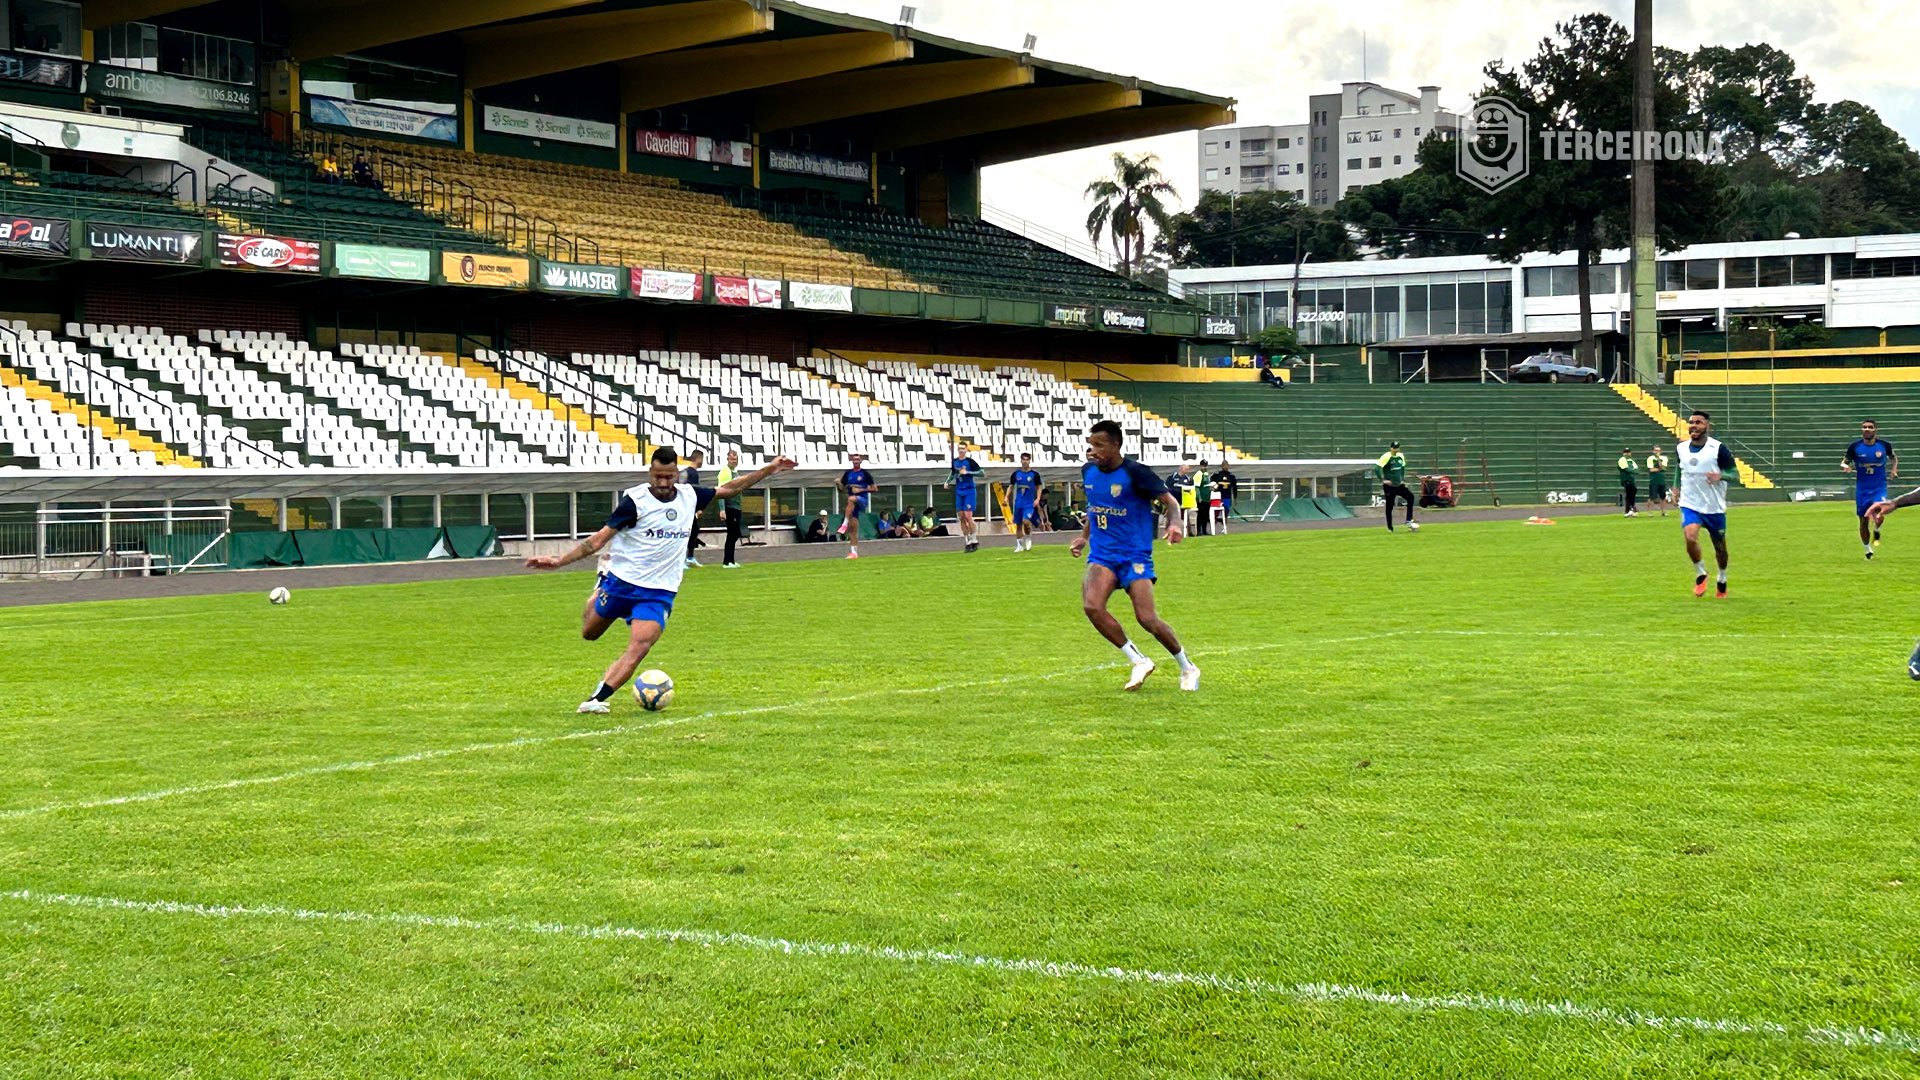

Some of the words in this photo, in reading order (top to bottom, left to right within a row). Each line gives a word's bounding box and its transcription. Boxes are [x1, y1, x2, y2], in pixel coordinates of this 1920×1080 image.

[105, 71, 165, 96] ambios
[645, 131, 690, 156] Cavaletti
[91, 231, 179, 252] LUMANTI
[246, 246, 260, 257] DE
[569, 270, 617, 290] MASTER
[1097, 515, 1107, 530] 19
